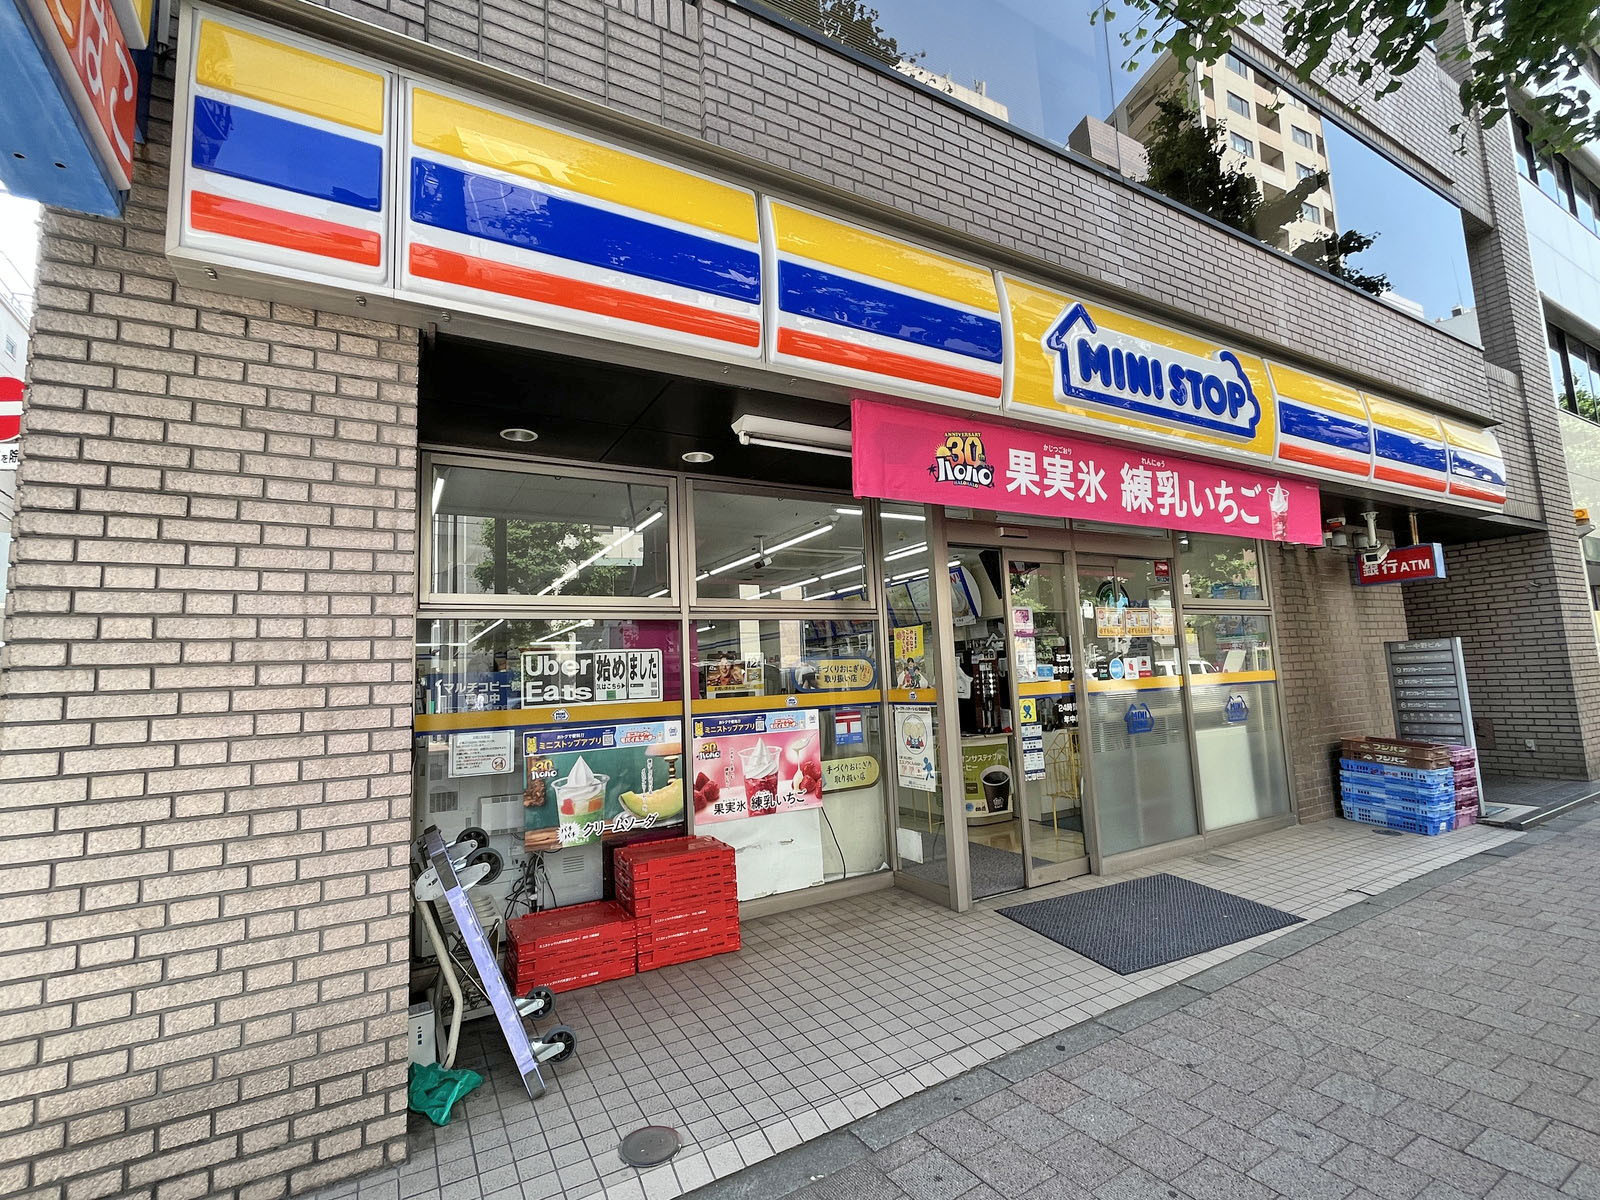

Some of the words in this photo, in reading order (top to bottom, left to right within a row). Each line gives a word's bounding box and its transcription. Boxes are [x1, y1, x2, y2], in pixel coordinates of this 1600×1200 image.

[1078, 337, 1164, 400] MINI
[1168, 364, 1246, 419] STOP
[1043, 444, 1072, 455] かじつごおり
[1141, 457, 1165, 468] れんにゅう
[1005, 448, 1108, 503] 果実氷
[1120, 462, 1262, 524] 練乳いちご
[525, 655, 592, 677] Uber
[596, 653, 657, 682] 始めました
[824, 673, 857, 684] 取り扱い店
[526, 680, 593, 702] Eats
[705, 723, 755, 733] ミニストップアプリ
[539, 737, 602, 749] ミニストップアプリ
[826, 761, 872, 774] 手づくりおにぎり
[834, 774, 866, 785] 取り扱い店
[714, 800, 746, 815] 果実氷
[751, 790, 806, 808] 練乳いちご
[583, 814, 657, 836] クリームソーダ
